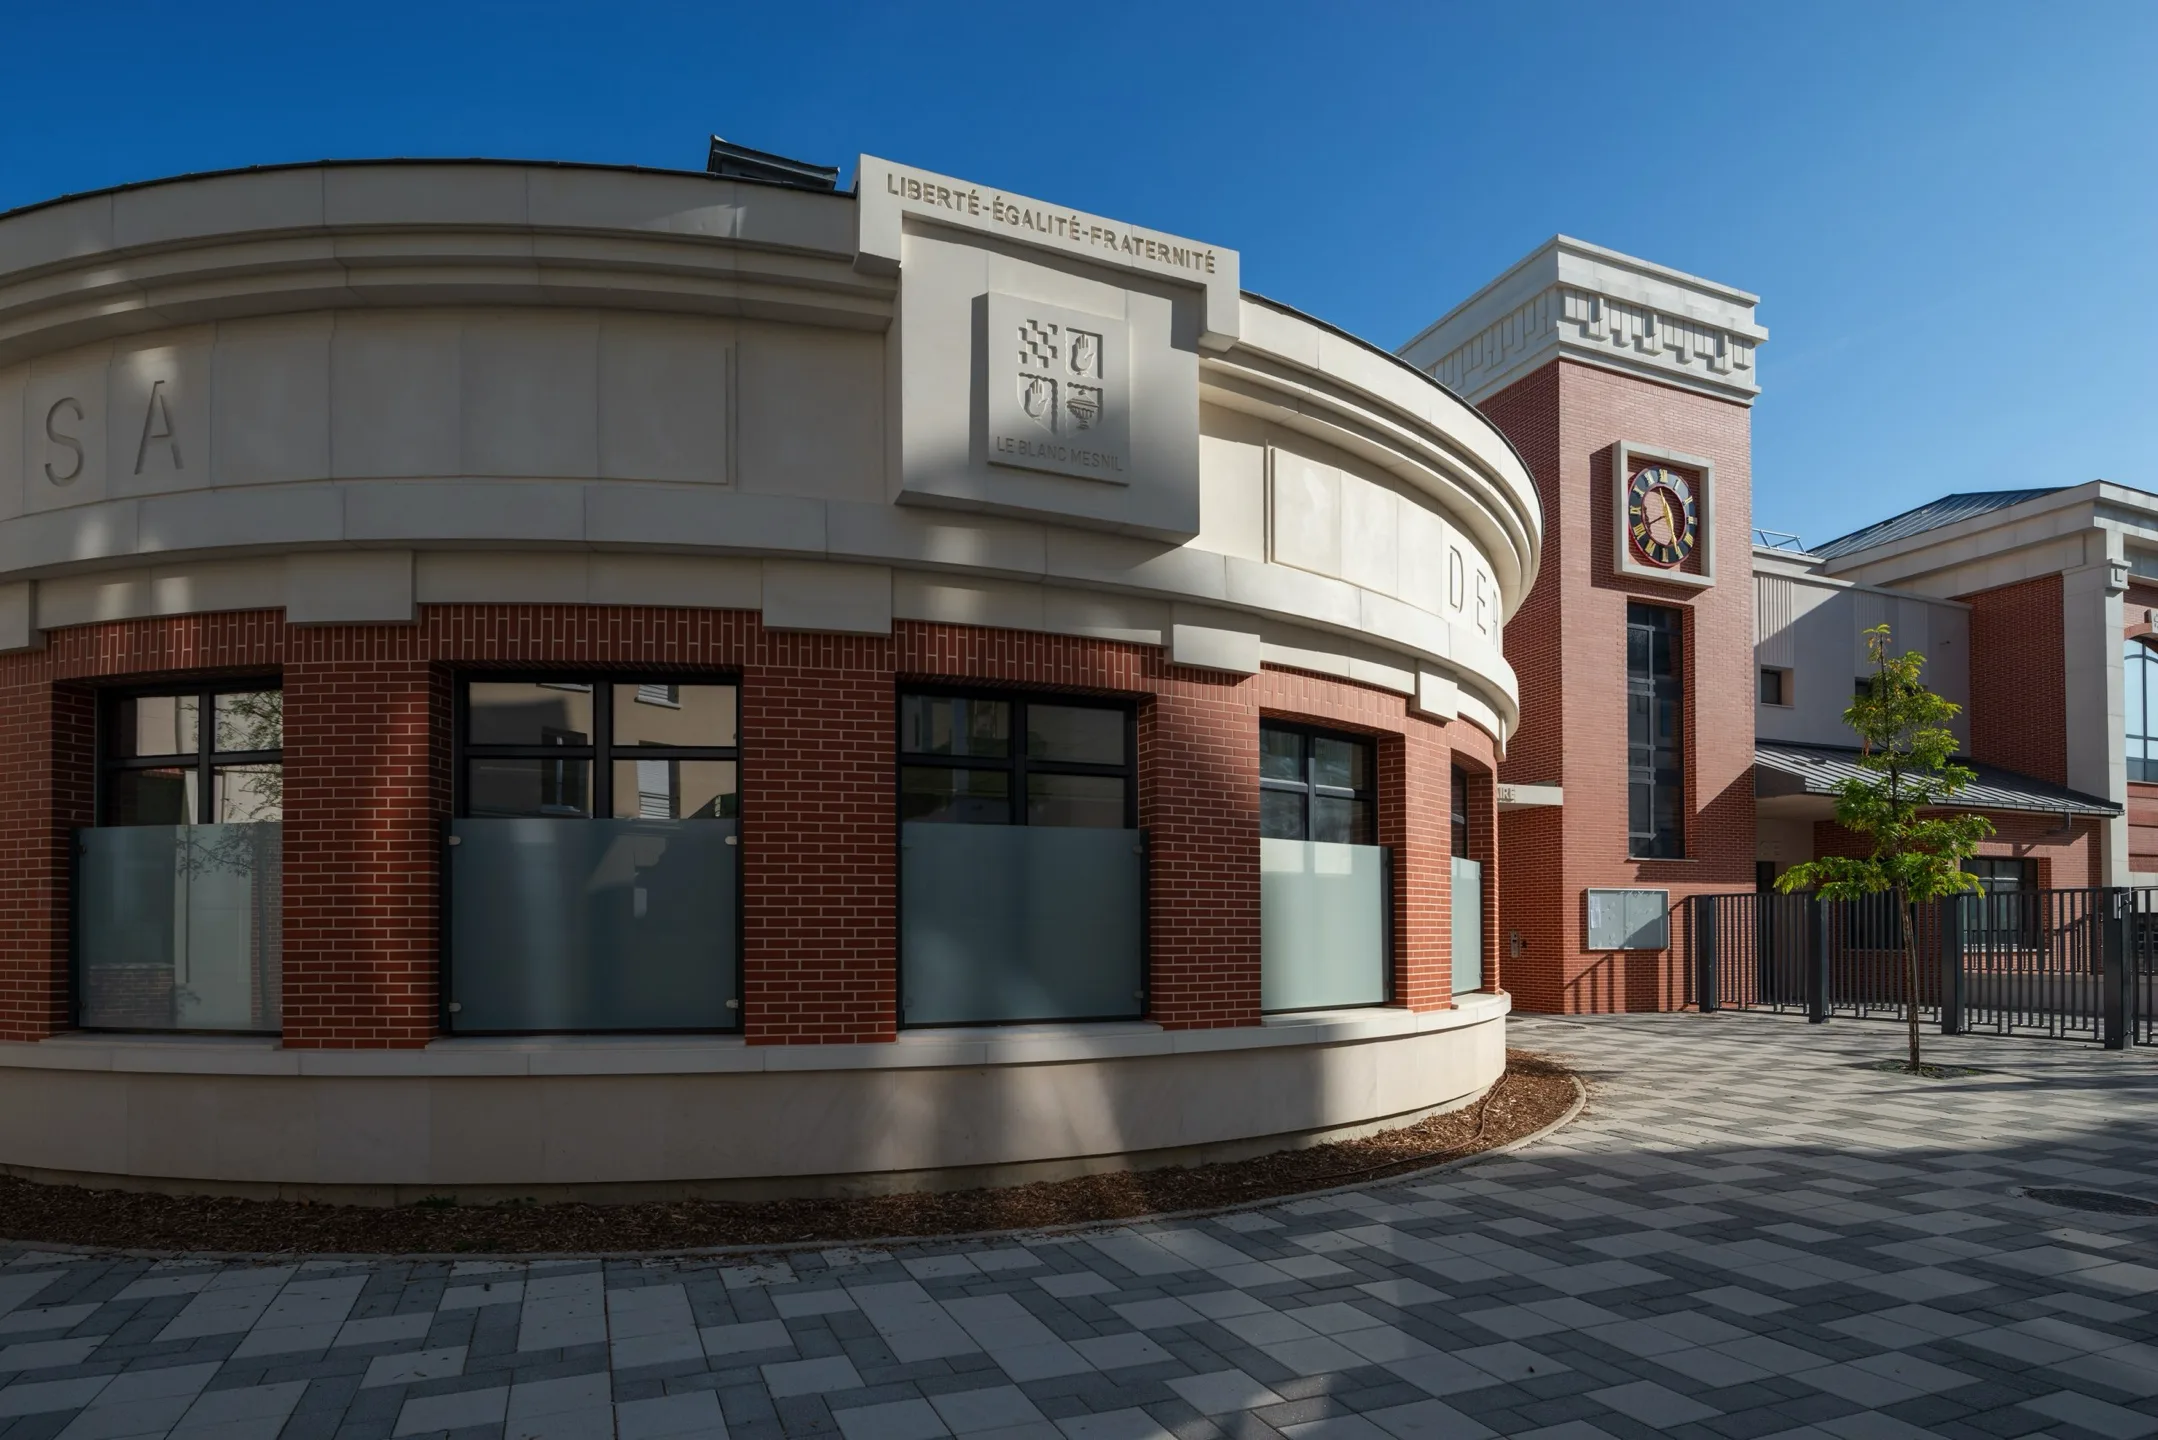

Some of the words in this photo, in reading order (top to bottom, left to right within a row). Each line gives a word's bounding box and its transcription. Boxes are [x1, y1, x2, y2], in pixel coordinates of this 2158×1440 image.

[44, 379, 184, 487] SA
[996, 435, 1015, 454] LE
[1018, 440, 1067, 462] BLANC
[1070, 448, 1124, 472] MESNIL
